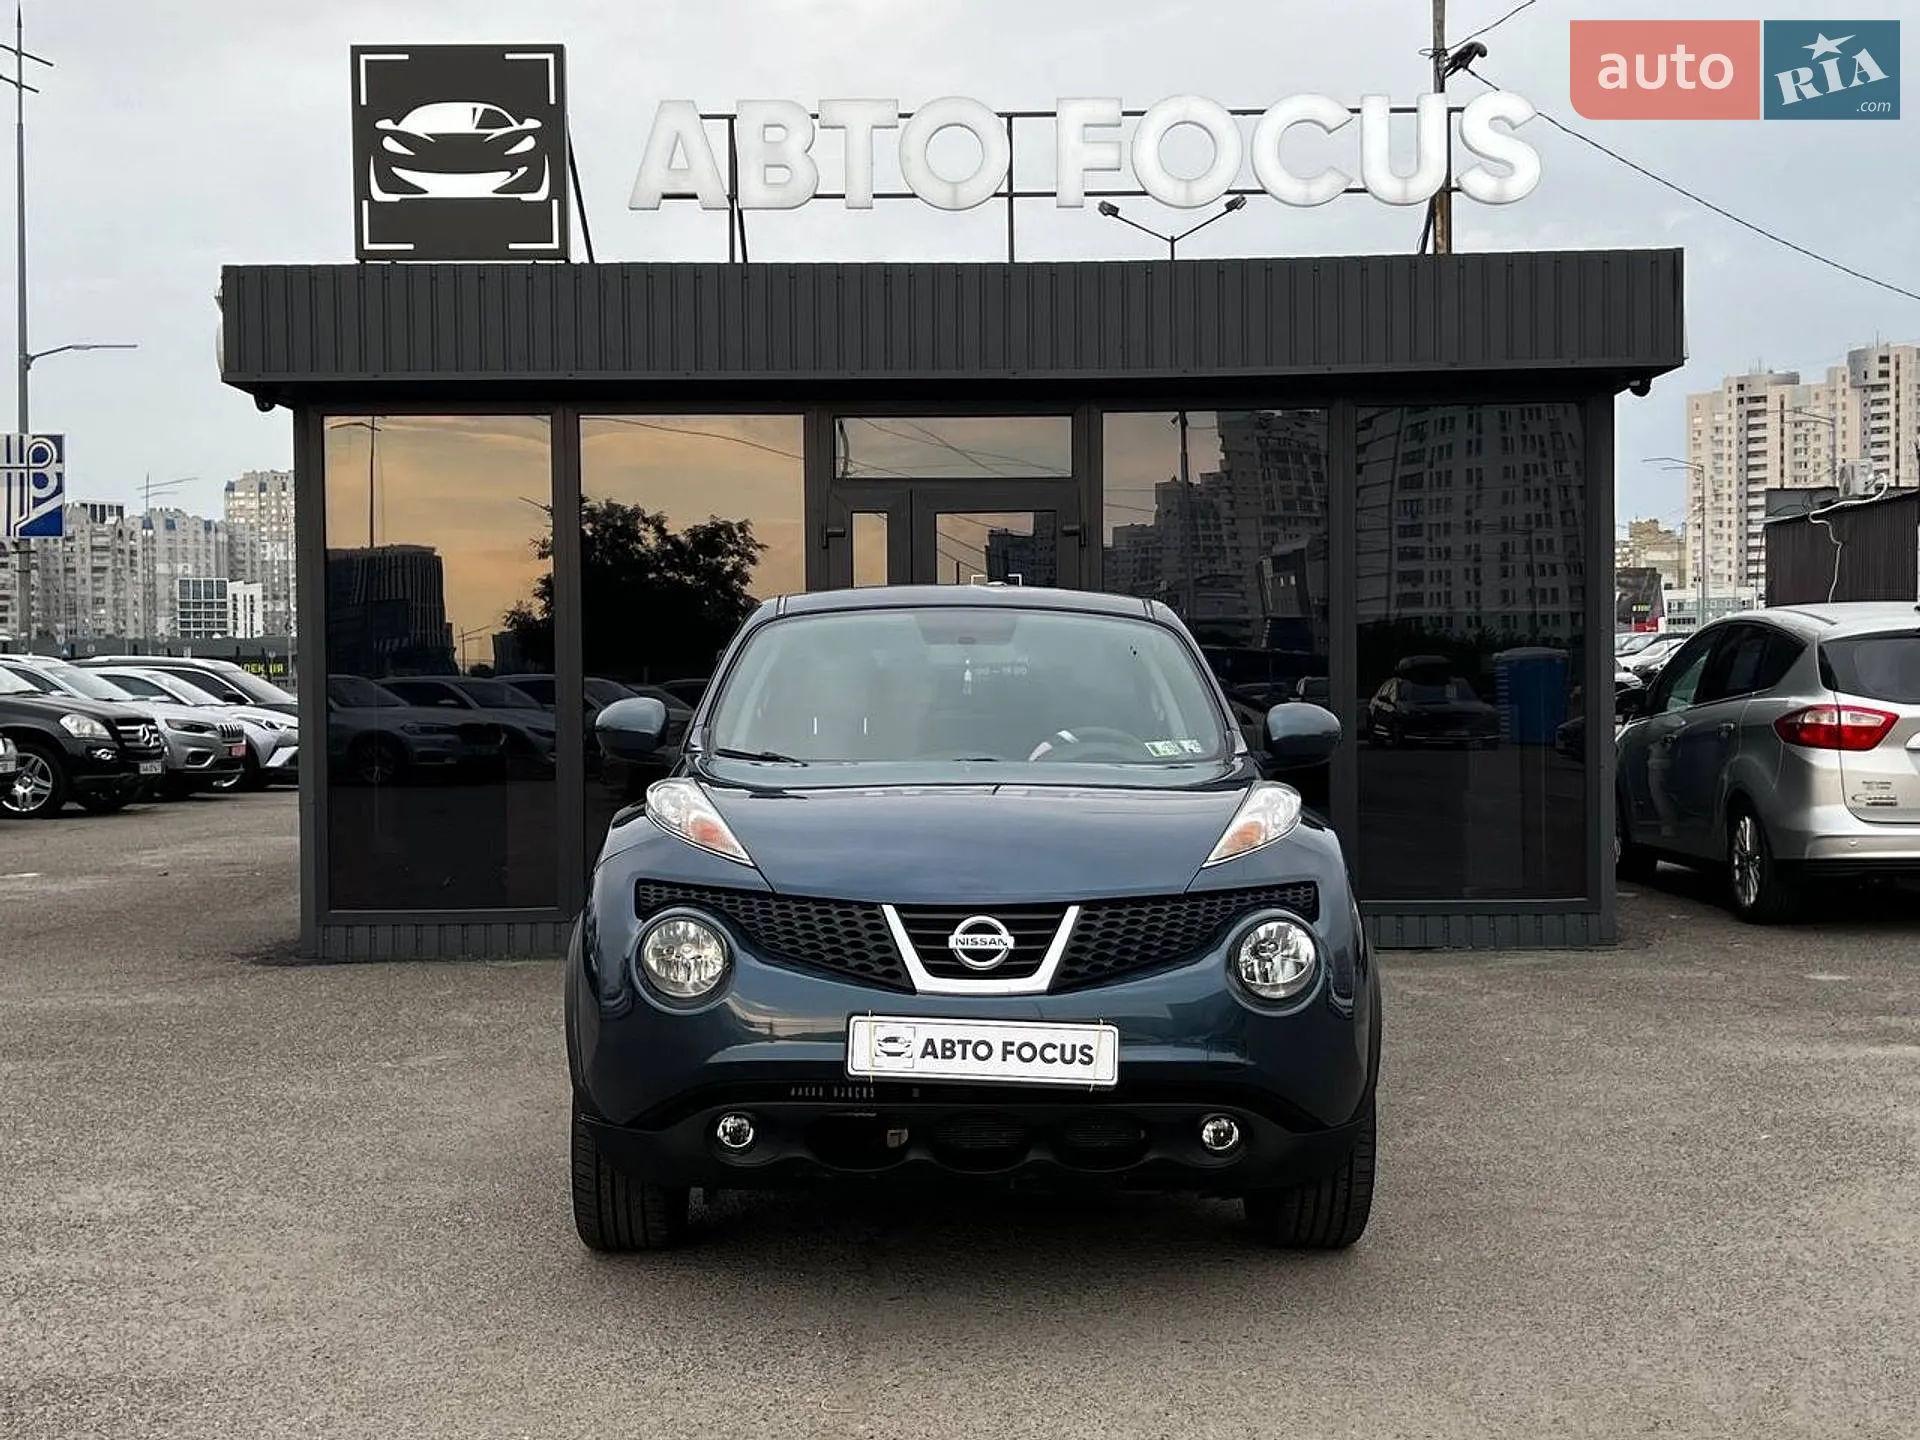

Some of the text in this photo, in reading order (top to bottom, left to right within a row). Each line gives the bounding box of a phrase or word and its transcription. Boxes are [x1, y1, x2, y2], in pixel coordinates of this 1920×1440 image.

[628, 91, 1541, 211] АВТО FOCUS
[955, 937, 1008, 946] NISSAN
[920, 1038, 1094, 1066] АВТО FOCUS
